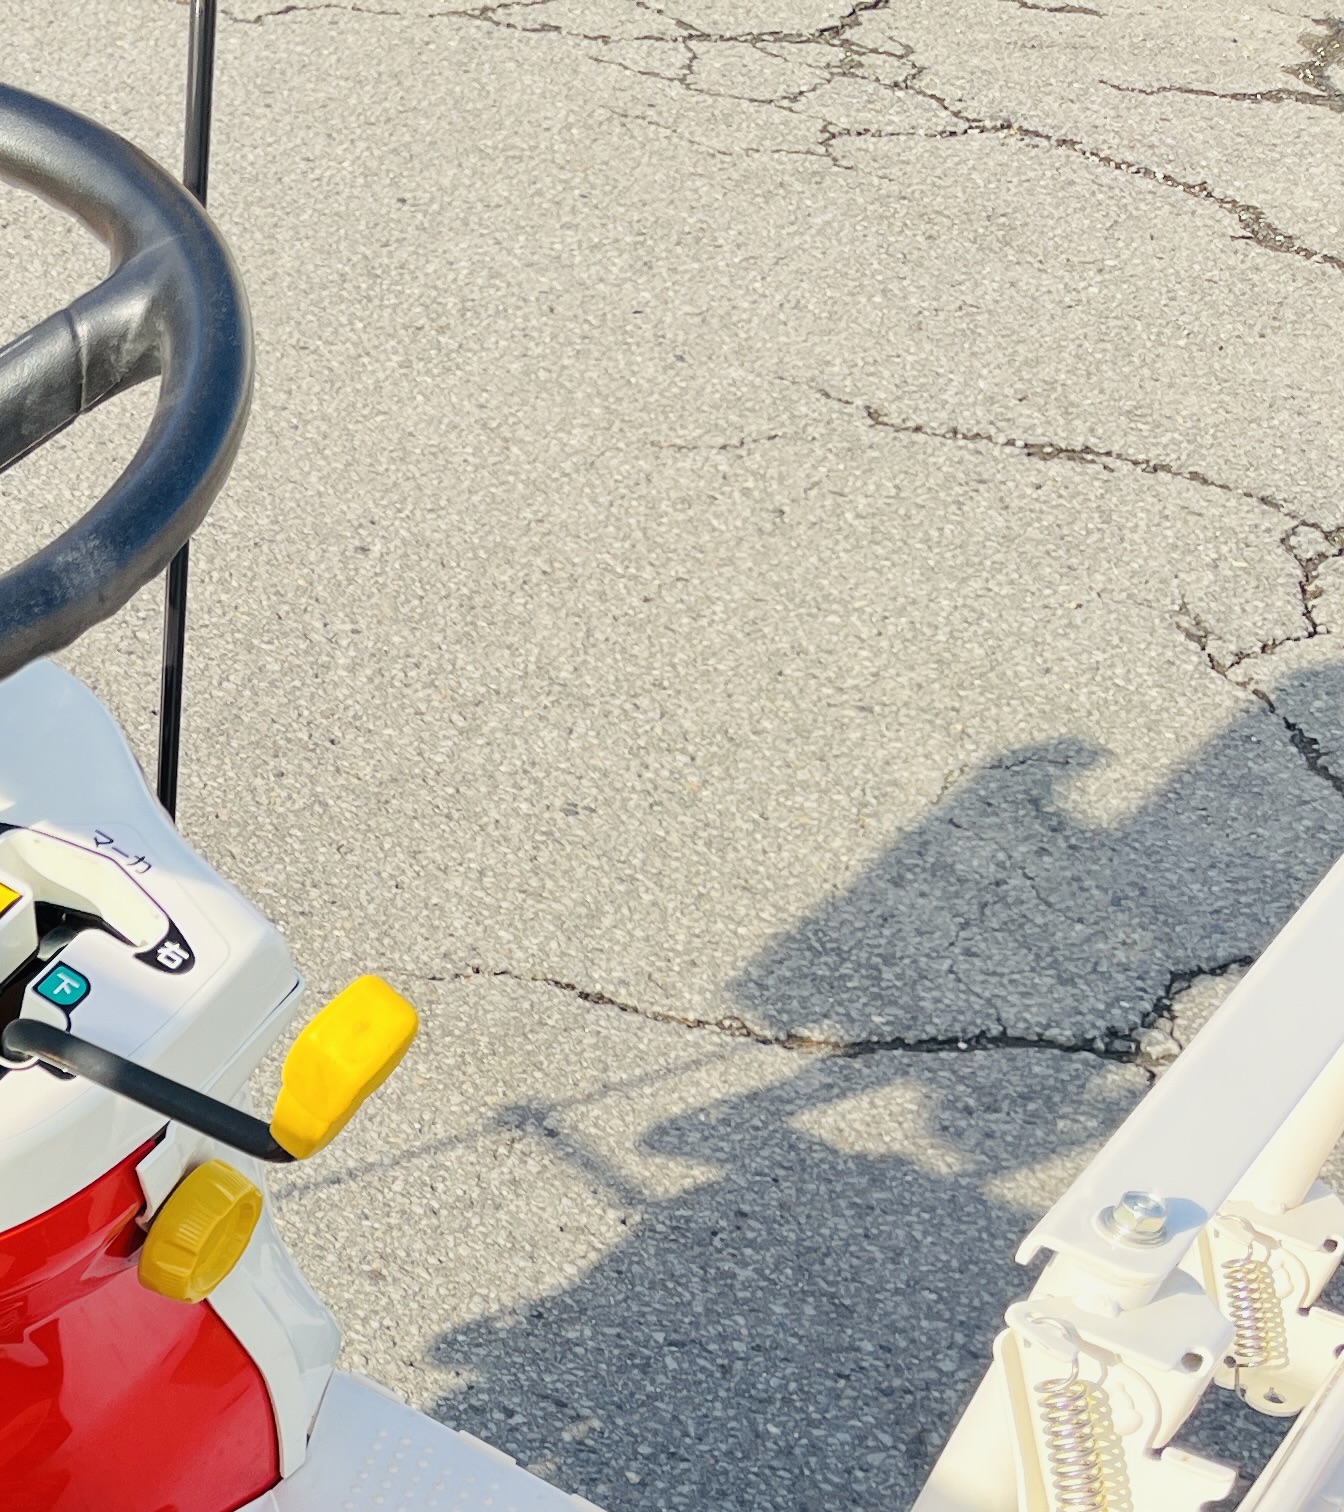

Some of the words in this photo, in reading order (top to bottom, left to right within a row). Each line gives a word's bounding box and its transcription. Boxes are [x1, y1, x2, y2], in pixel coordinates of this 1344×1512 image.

[93, 830, 152, 874] マーカ
[156, 941, 190, 969] 右
[53, 972, 81, 996] 下
